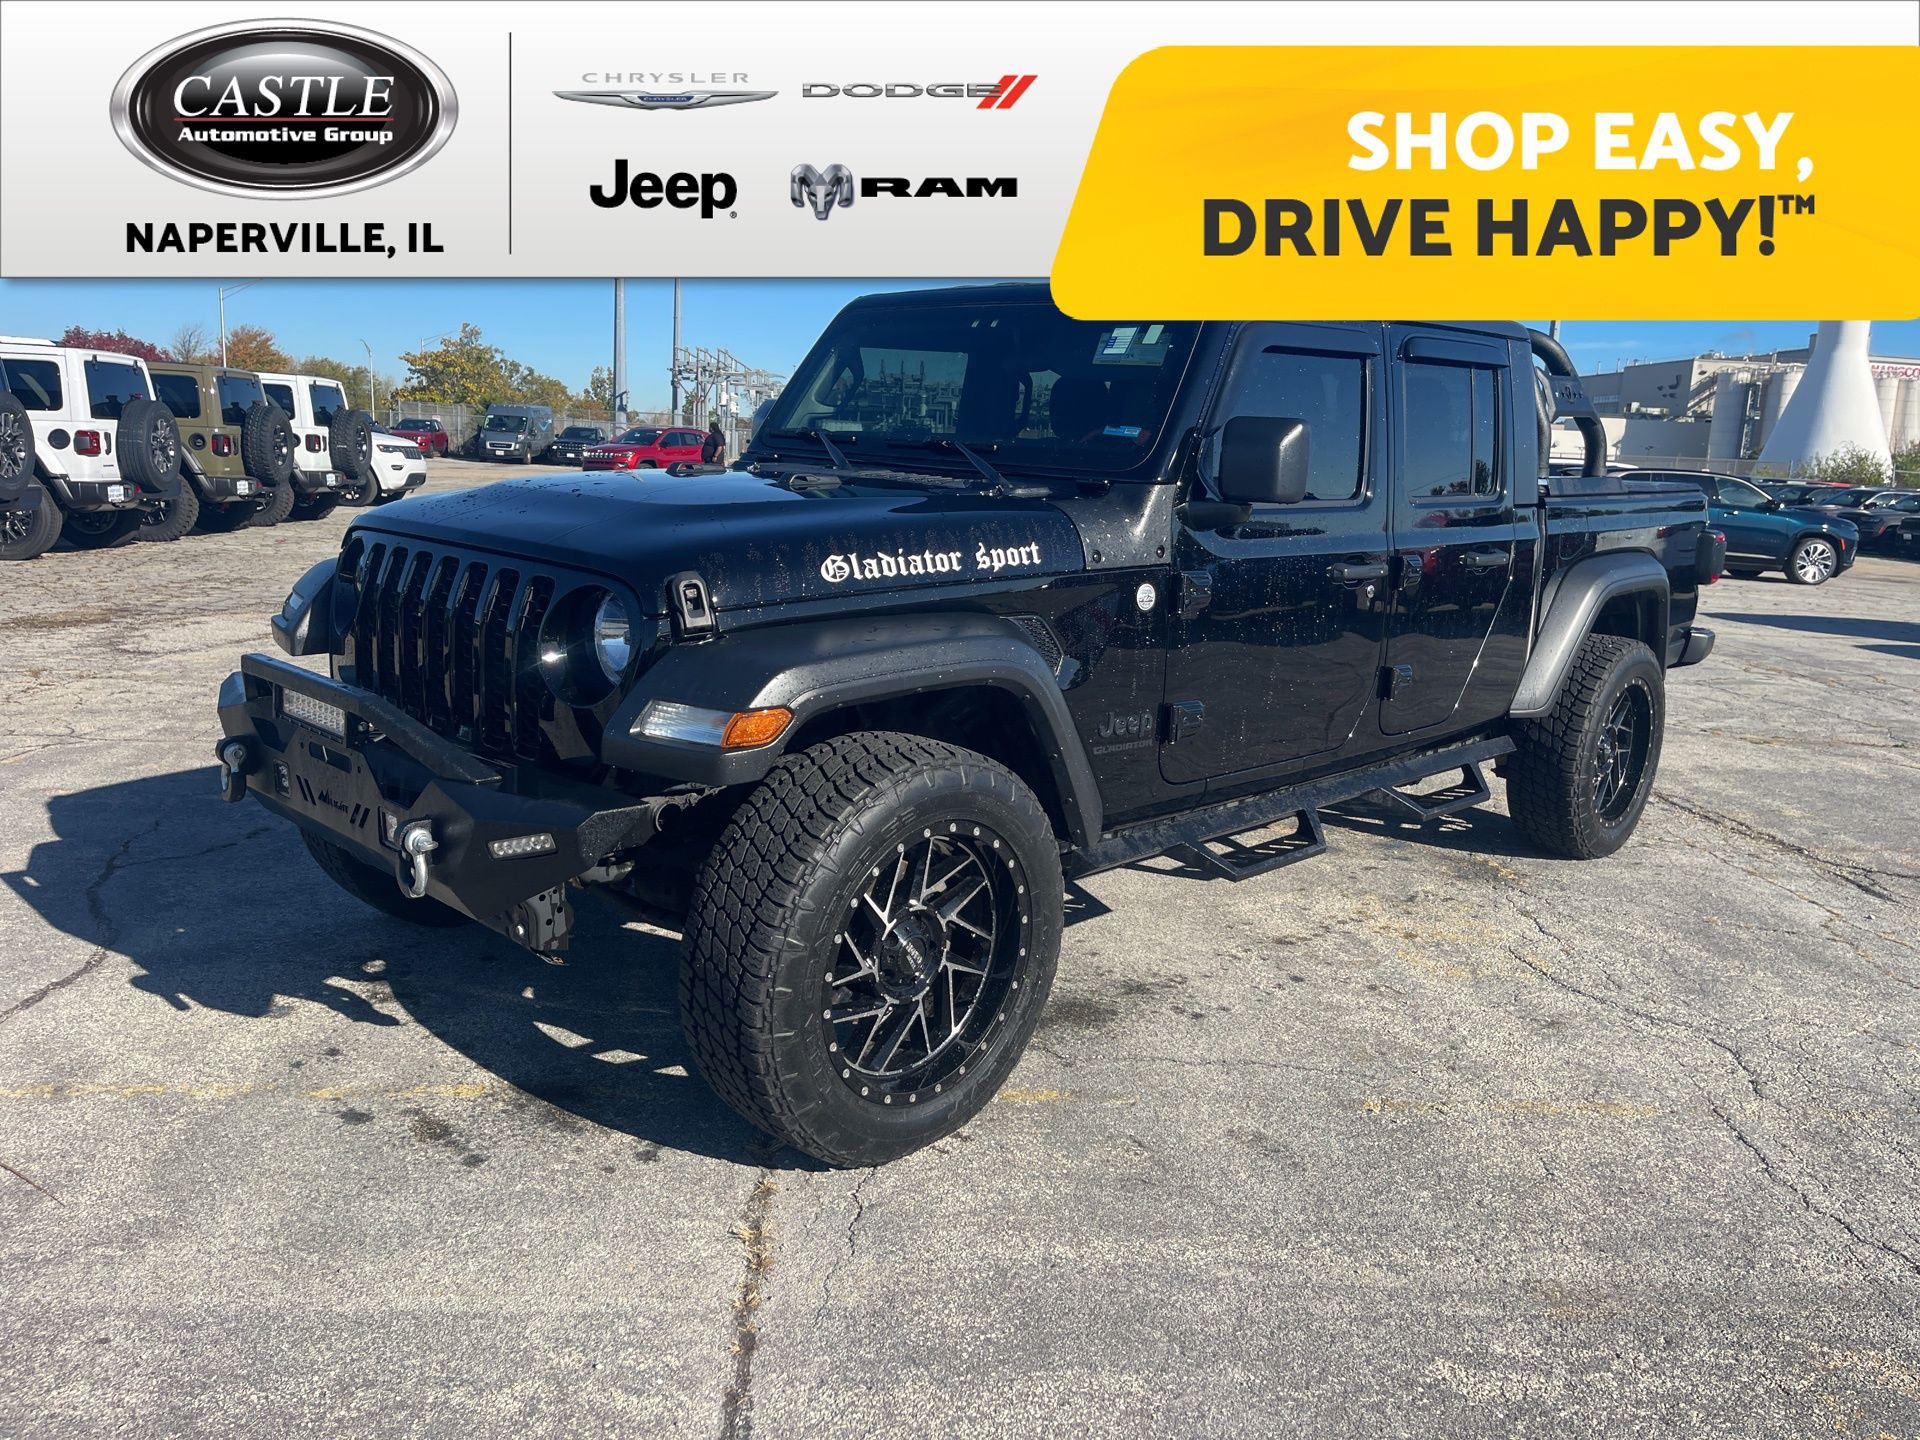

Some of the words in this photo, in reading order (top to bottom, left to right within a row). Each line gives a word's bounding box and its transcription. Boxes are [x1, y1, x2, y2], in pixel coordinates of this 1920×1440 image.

[820, 549, 963, 583] Gladiator
[1098, 711, 1153, 738] Jeep
[1093, 738, 1153, 755] GLADIATOR
